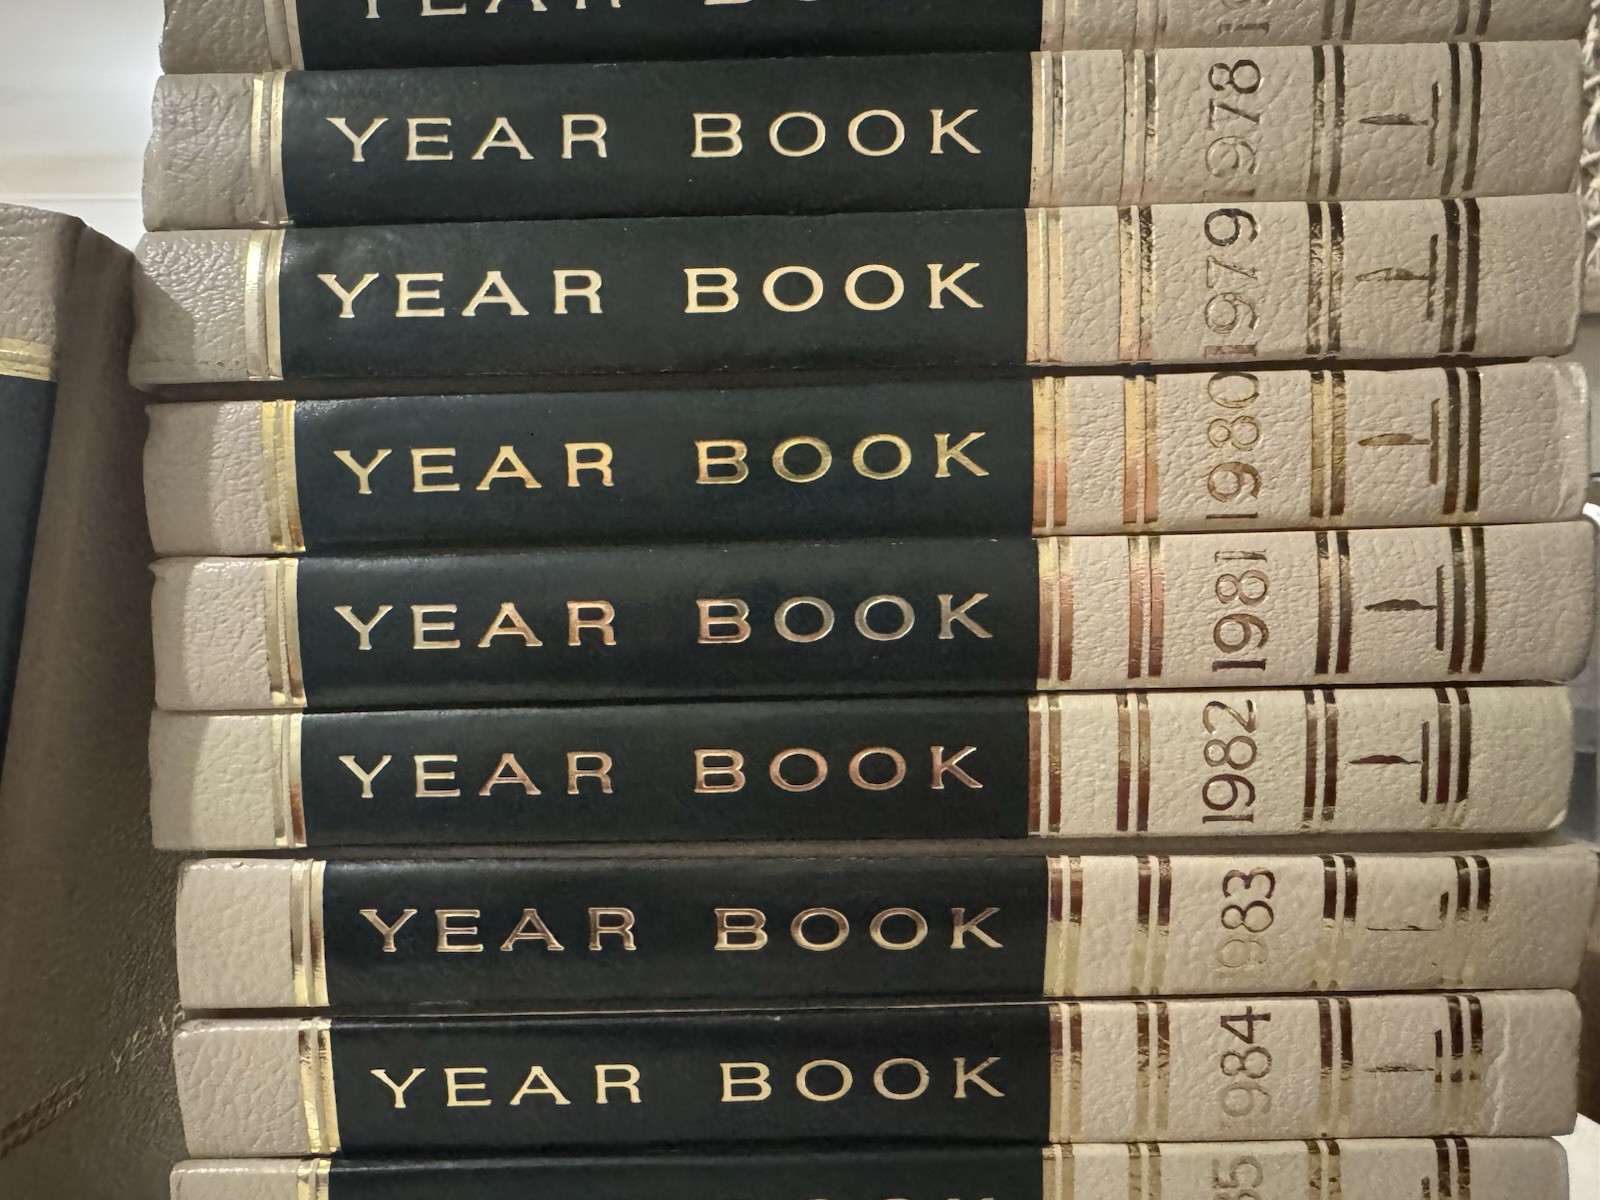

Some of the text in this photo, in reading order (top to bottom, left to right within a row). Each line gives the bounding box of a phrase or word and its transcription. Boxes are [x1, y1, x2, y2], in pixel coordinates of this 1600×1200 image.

[325, 109, 982, 162] YEAR BOOK
[1202, 59, 1262, 200] 1978
[317, 263, 985, 319] YEAR BOOK
[1203, 207, 1259, 358] 1979
[333, 432, 990, 494] YEAR BOOK
[1205, 371, 1263, 520] 1980
[334, 593, 993, 650] YEAR BOOK
[1211, 549, 1270, 673] 1981
[338, 746, 984, 799] YEAR BOOK
[1201, 699, 1259, 825] 1982
[359, 907, 1004, 953] YEAR BOOK
[370, 1056, 1006, 1109] YEAR BOOK
